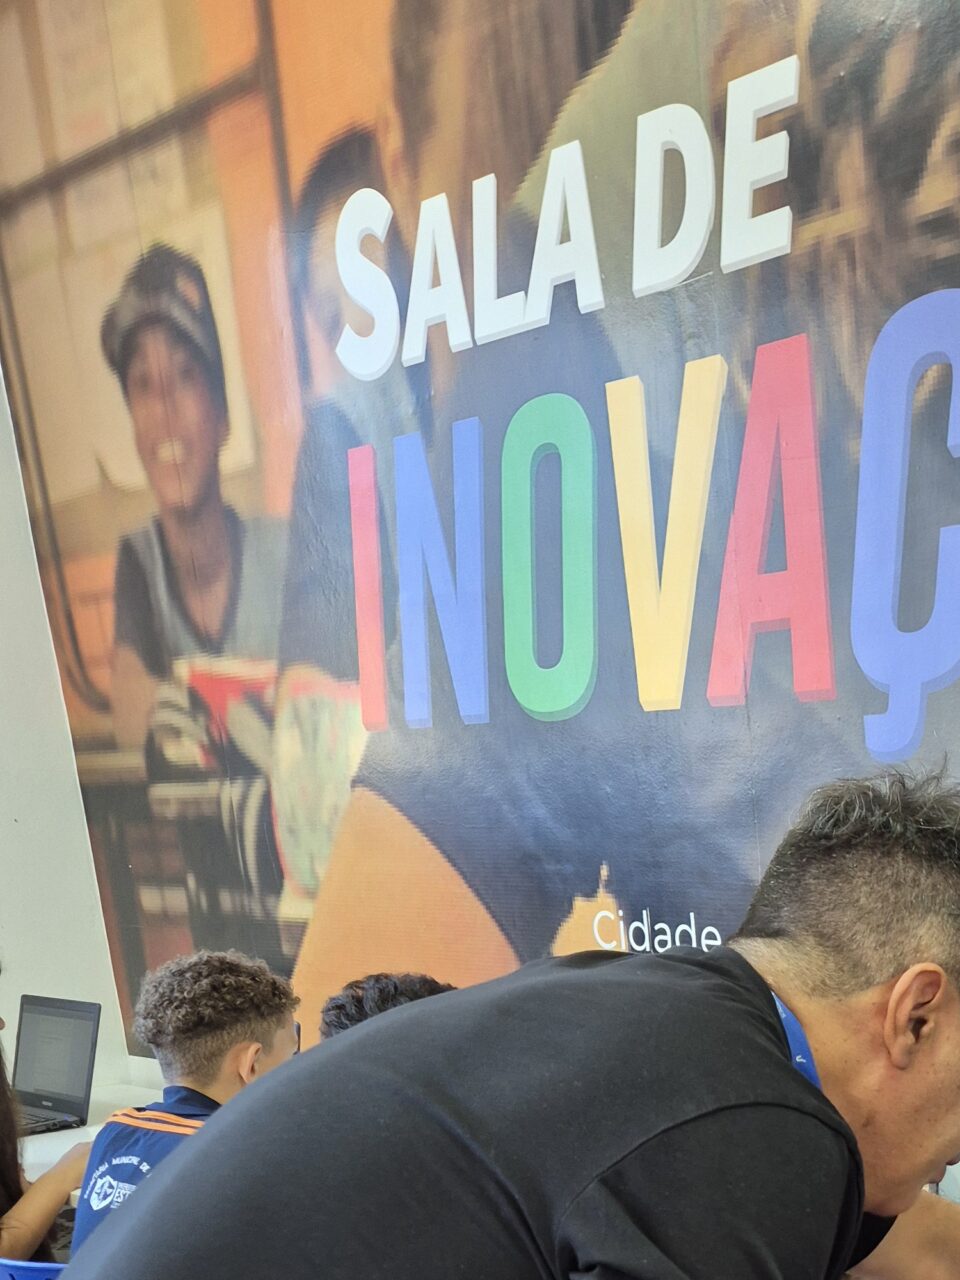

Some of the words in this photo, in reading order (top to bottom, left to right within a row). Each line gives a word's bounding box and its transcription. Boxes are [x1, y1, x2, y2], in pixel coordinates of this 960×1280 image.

[334, 140, 605, 381] SALA
[632, 54, 800, 298] DE
[592, 908, 722, 953] Cidade
